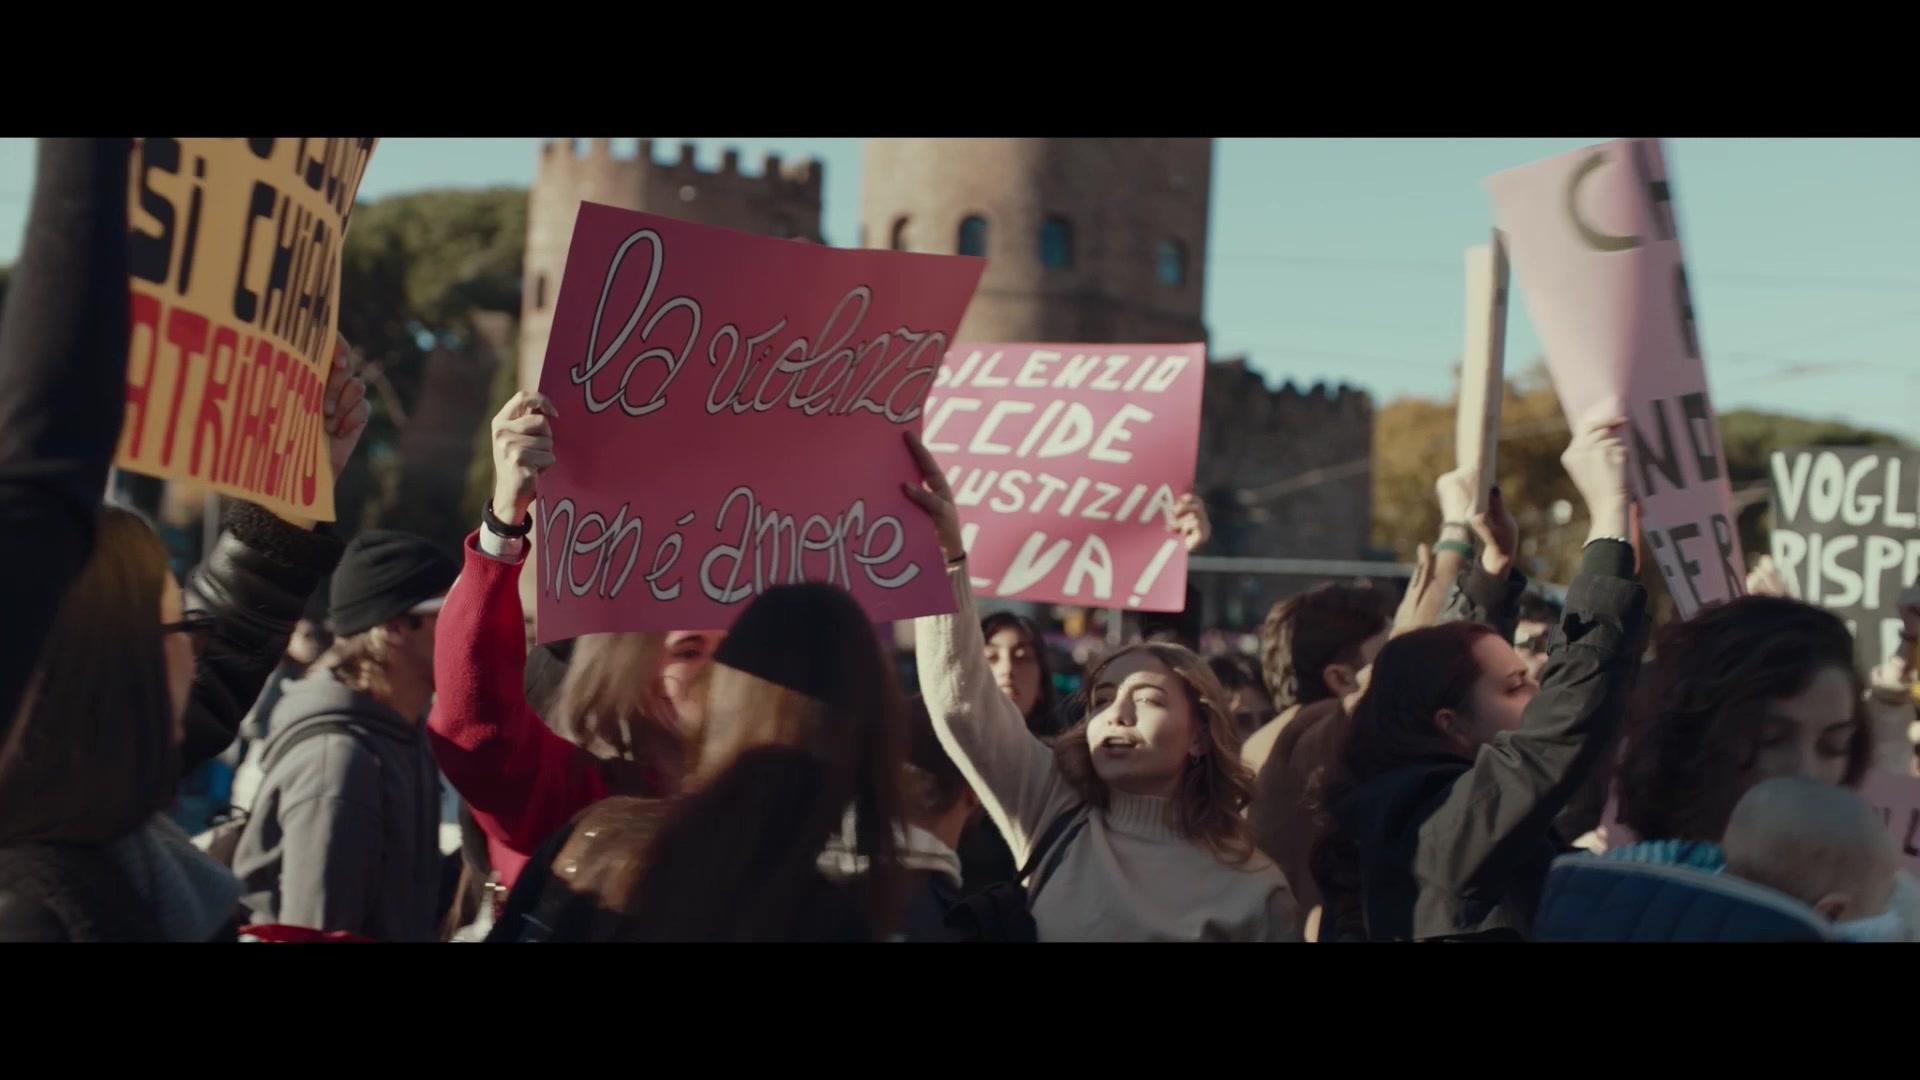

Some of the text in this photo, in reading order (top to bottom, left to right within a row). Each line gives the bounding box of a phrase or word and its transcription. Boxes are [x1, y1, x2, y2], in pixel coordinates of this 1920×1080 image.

[571, 228, 946, 424] la violenza
[921, 396, 1153, 463] CCIDE
[947, 465, 1178, 523] USTIZIA
[1770, 451, 1920, 529] VOGL
[538, 497, 643, 604] non
[699, 486, 920, 604] amore
[1770, 528, 1920, 610] RISP
